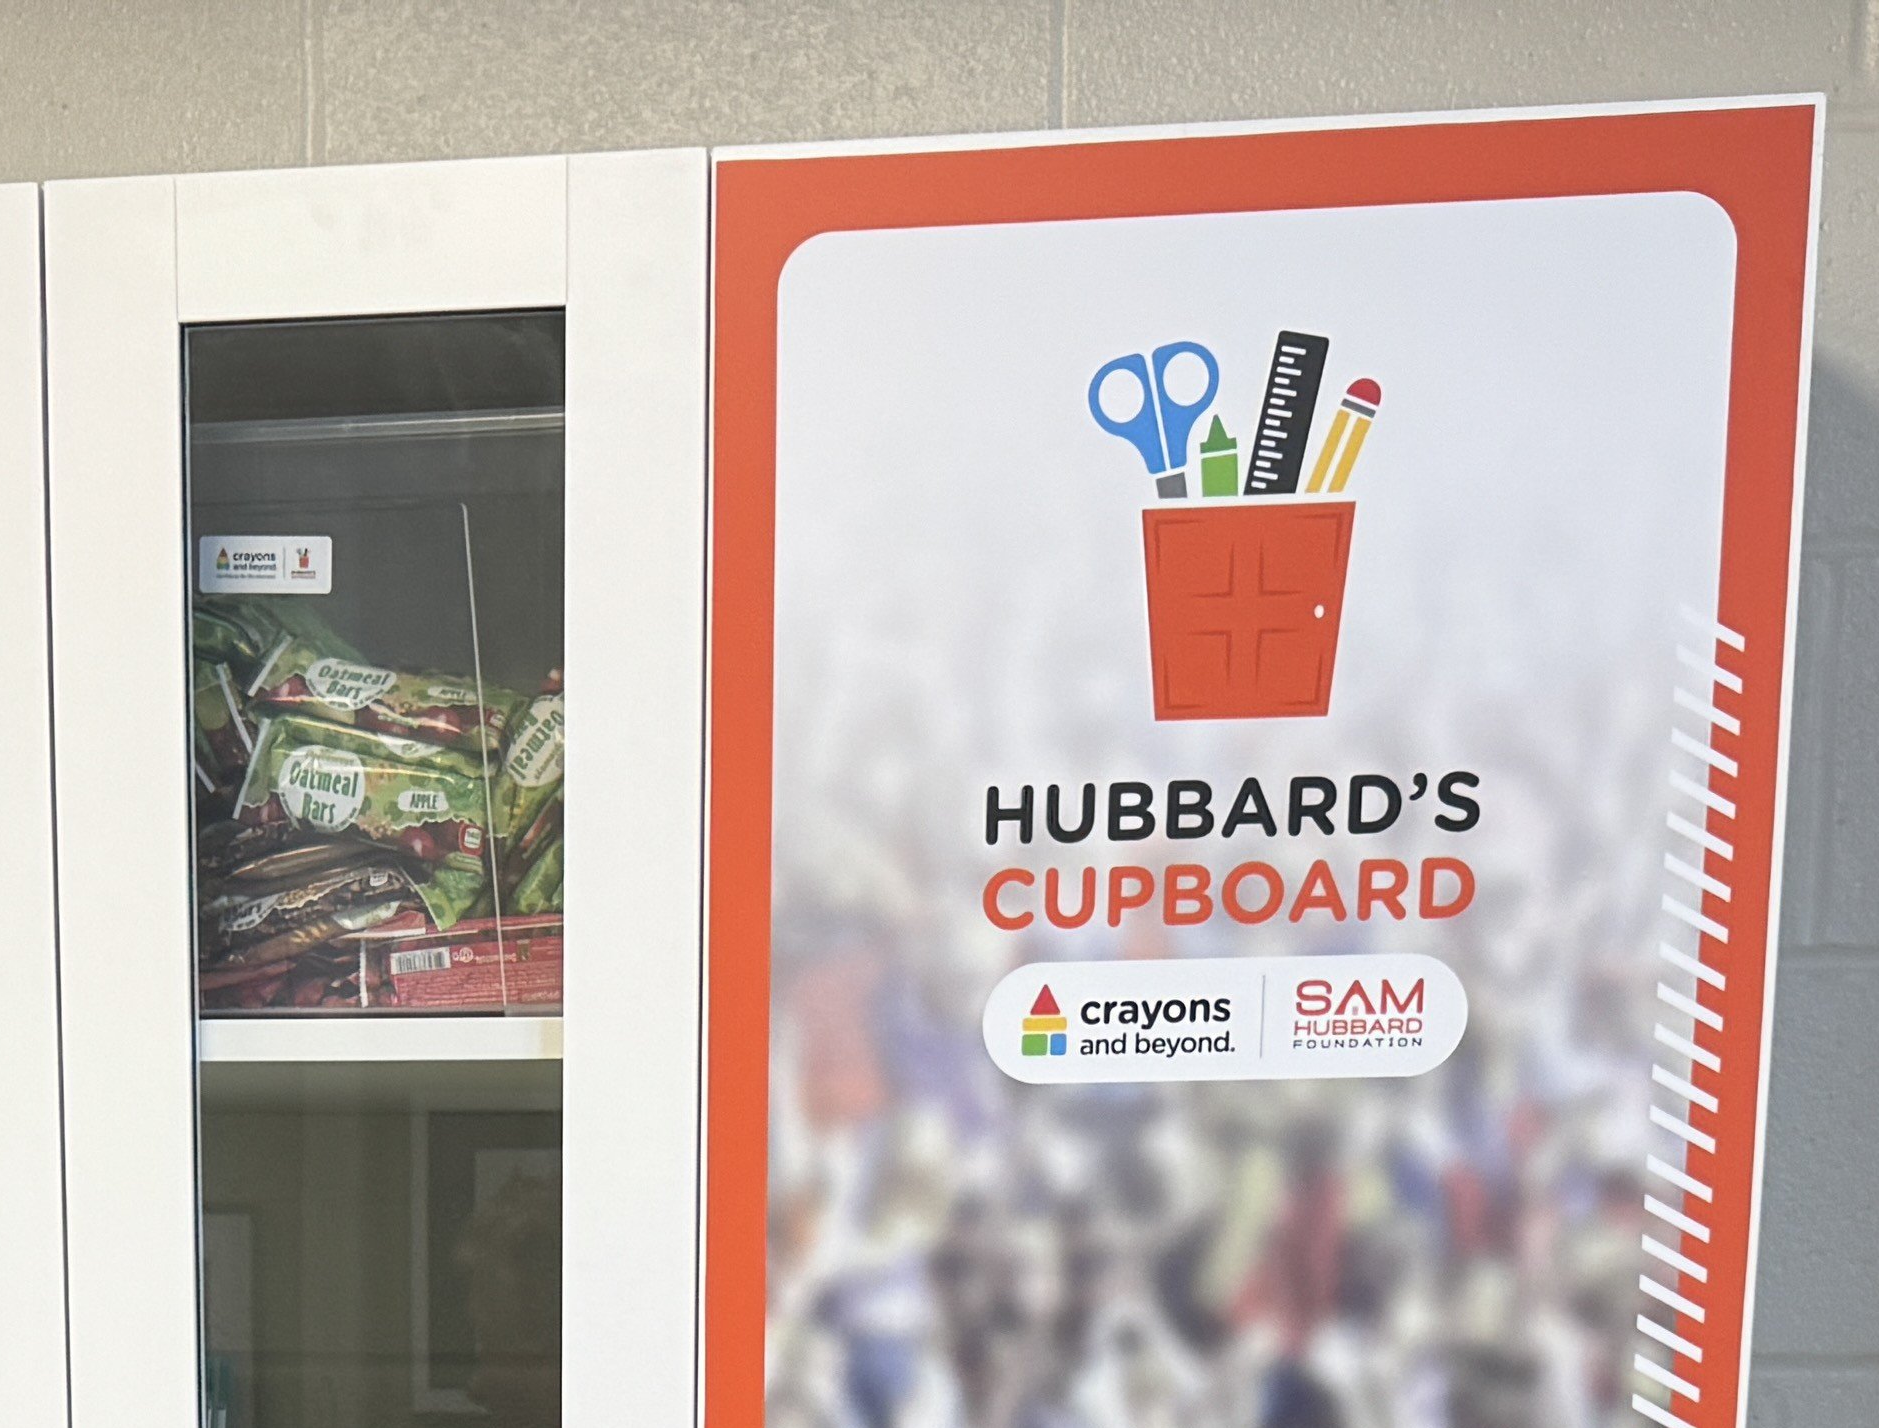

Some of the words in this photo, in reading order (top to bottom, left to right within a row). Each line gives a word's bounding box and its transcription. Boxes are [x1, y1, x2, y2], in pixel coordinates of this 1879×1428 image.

[233, 552, 276, 562] crayons
[318, 664, 389, 687] Oatmeal
[327, 680, 362, 698] Bars
[289, 760, 358, 798] Oatmeal
[301, 794, 336, 824] Bars
[409, 794, 439, 810] APPLE
[981, 858, 1476, 930] CUPBOARD
[1295, 977, 1425, 1017] SAM
[1080, 997, 1231, 1030] crayons
[1294, 1017, 1423, 1036] HUBBARD
[1080, 1033, 1127, 1056] and
[1135, 1031, 1236, 1058] beyond.
[1293, 1037, 1423, 1049] FOUNDATION
